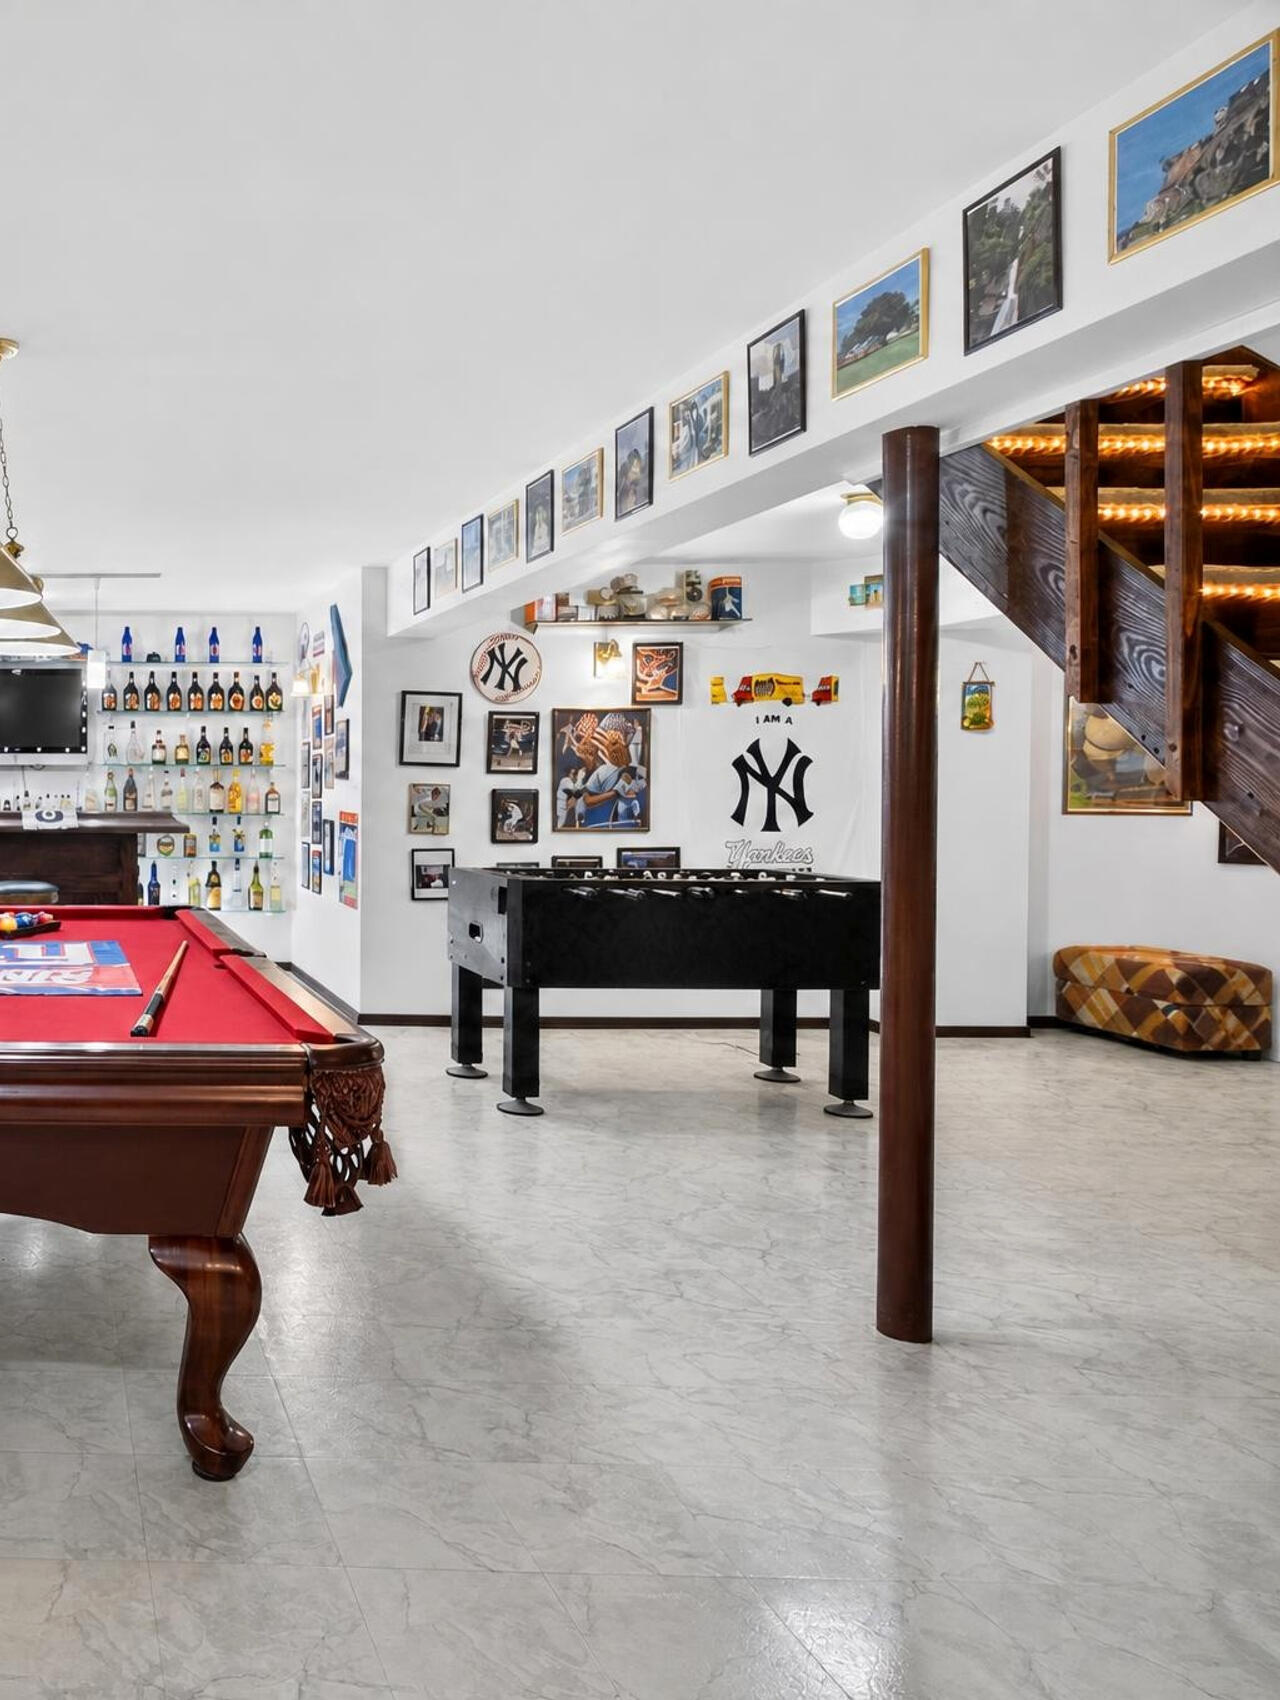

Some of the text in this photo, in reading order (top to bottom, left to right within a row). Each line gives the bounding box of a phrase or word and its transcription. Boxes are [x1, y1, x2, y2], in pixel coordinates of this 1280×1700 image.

[480, 642, 528, 692] NY
[763, 714, 781, 724] AM
[785, 716, 793, 725] A
[730, 738, 814, 832] NY
[725, 839, 814, 869] Yankees
